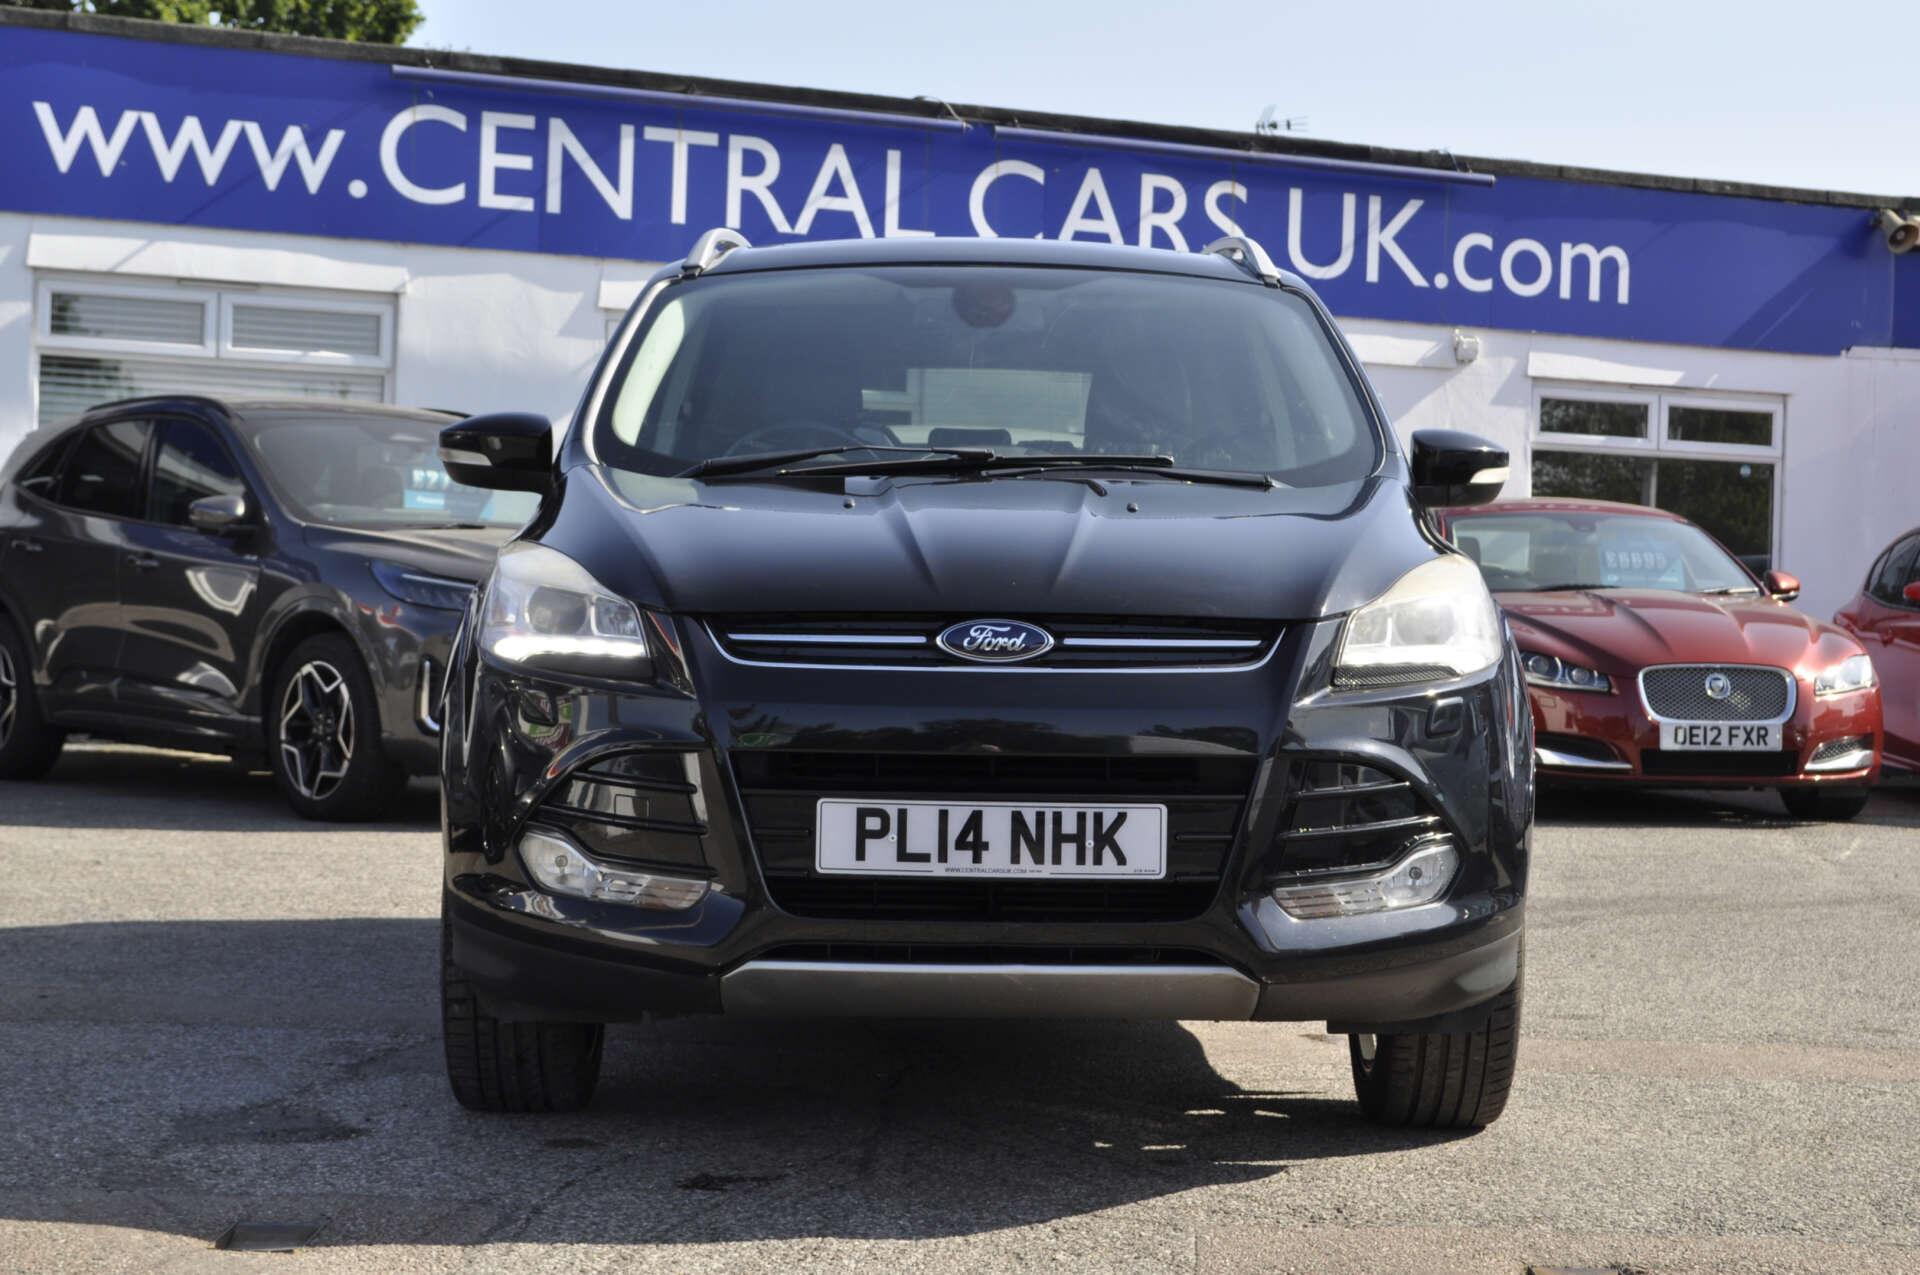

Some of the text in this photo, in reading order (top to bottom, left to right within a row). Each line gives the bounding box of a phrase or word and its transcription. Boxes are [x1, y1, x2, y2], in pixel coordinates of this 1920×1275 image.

[1288, 187, 1631, 305] UK.com
[963, 625, 1027, 651] Ford
[1728, 725, 1768, 746] FXR
[855, 807, 1128, 866] PL14 NHK
